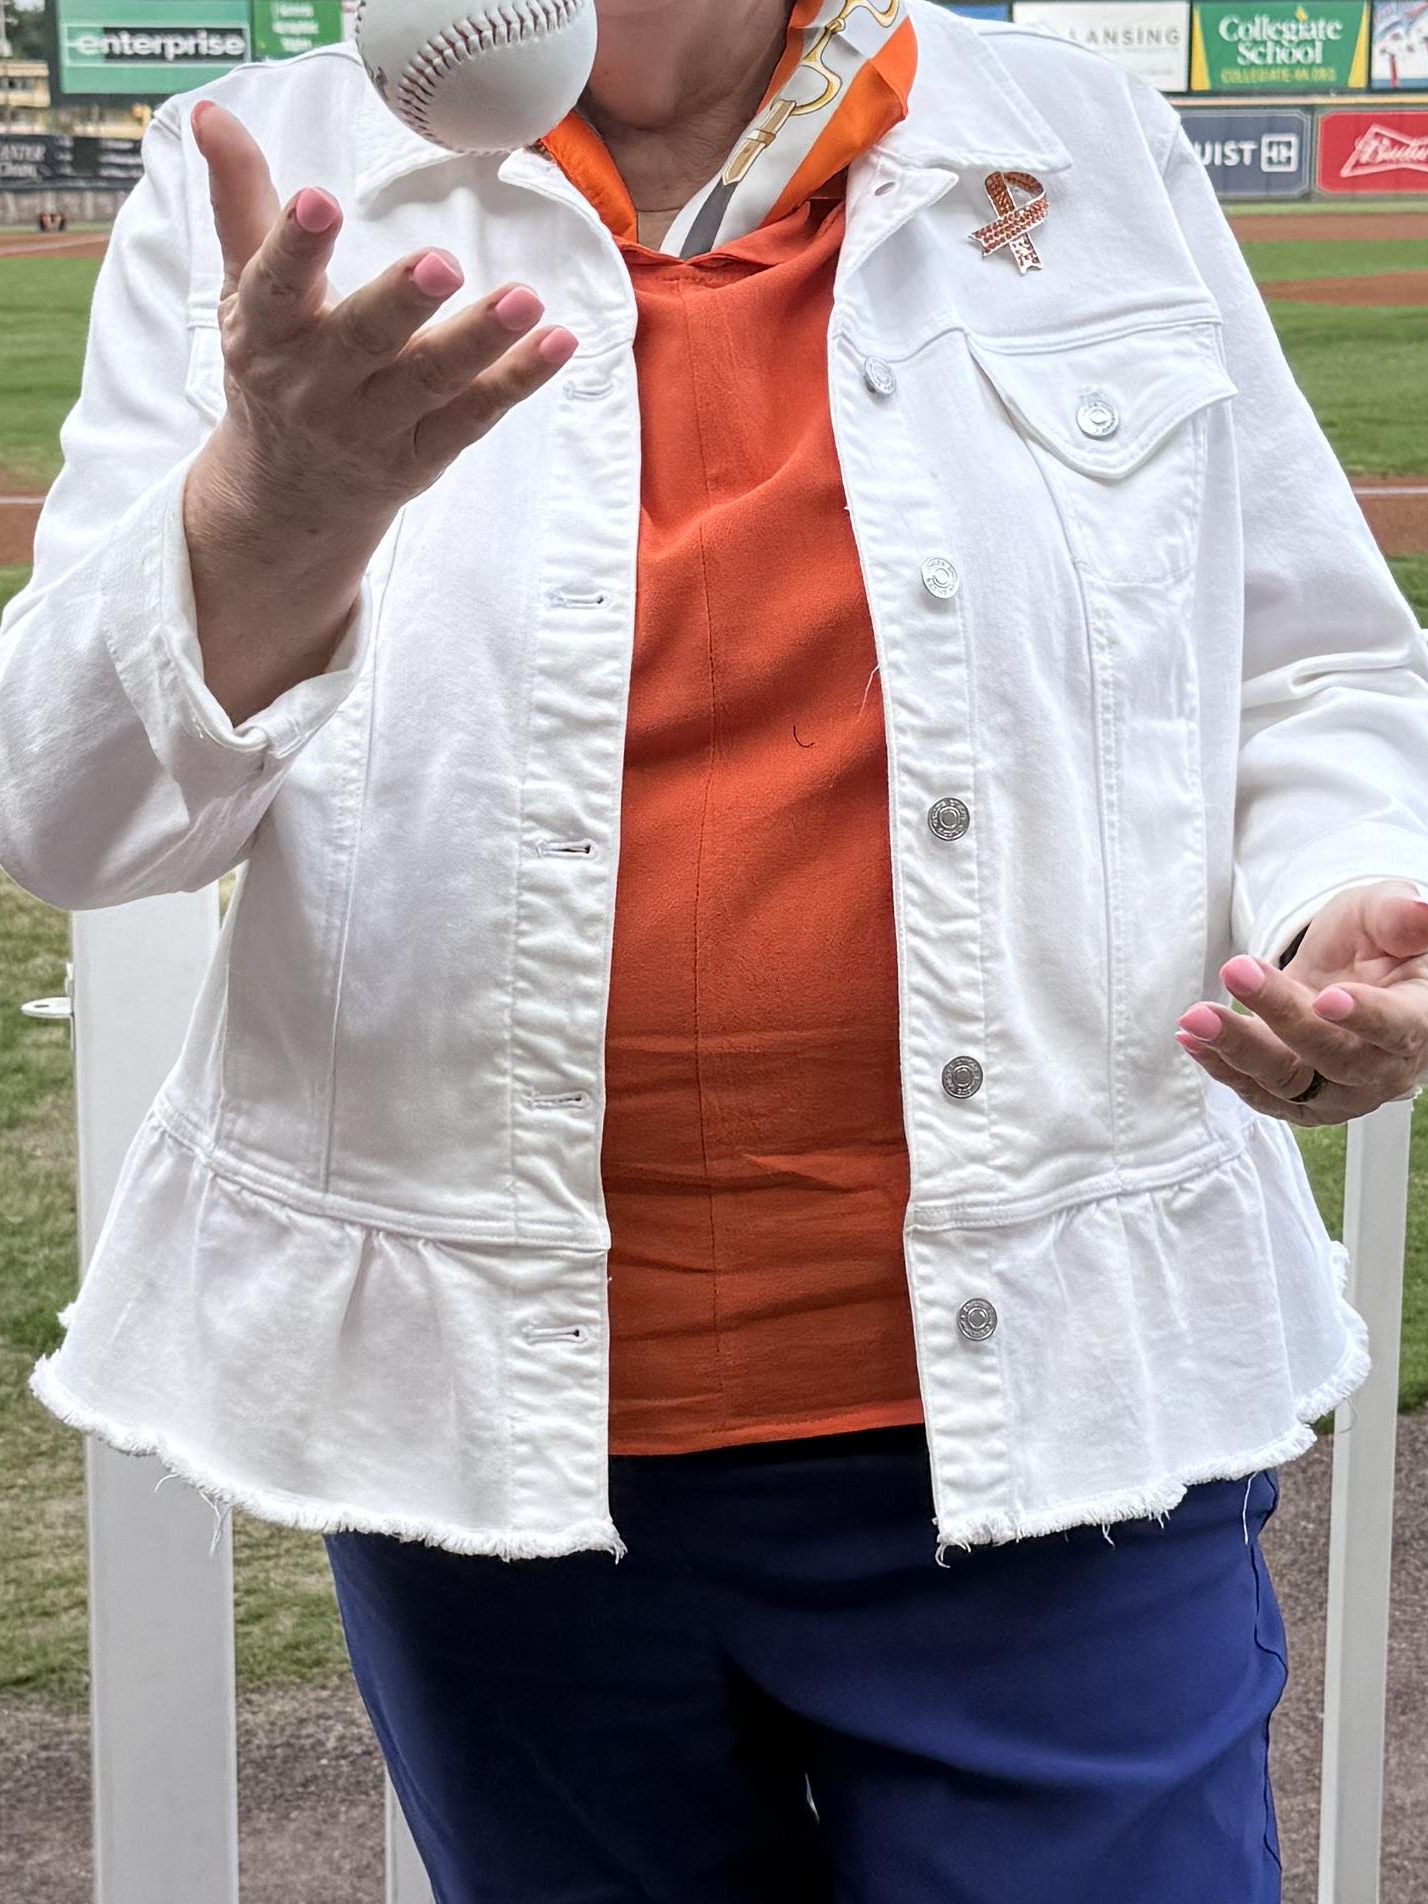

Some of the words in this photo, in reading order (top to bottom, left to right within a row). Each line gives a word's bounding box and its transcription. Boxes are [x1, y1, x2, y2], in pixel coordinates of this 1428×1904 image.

[1219, 15, 1343, 47] Collegiate
[74, 30, 247, 61] enterprise
[1237, 41, 1323, 65] School
[1201, 140, 1258, 166] UIST
